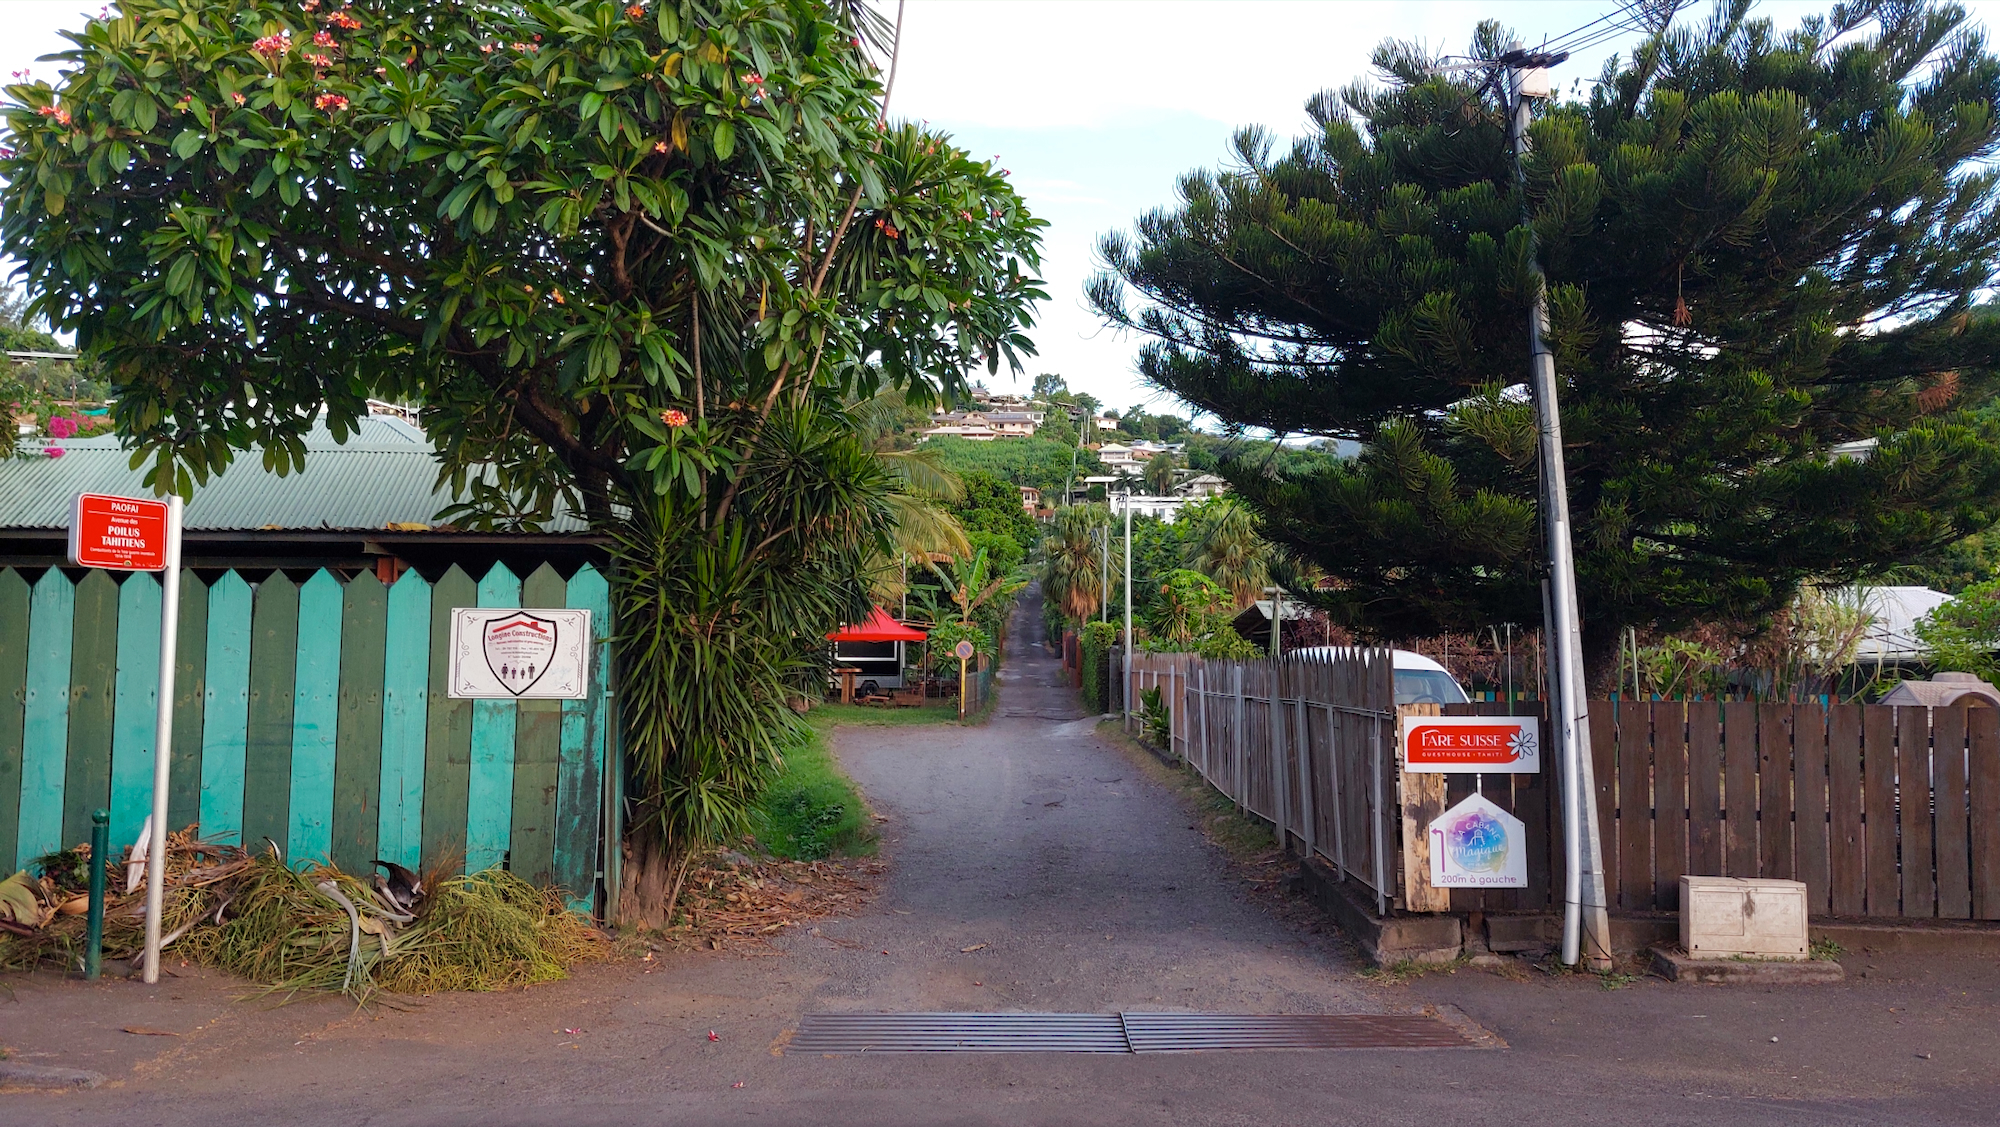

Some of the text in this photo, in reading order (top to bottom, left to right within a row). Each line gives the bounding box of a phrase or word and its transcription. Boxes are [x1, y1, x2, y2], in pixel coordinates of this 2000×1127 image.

[111, 502, 139, 513] PAOFAI
[111, 516, 129, 524] Avenue
[107, 525, 140, 537] POILUS
[101, 535, 146, 549] TAHITIENS
[487, 631, 511, 641] Longine
[511, 629, 553, 642] Constructions
[1421, 729, 1502, 746] FARE SUISSE
[1455, 821, 1501, 841] LA CABANE
[1455, 844, 1504, 860] Magique
[1441, 875, 1517, 885] 200m à gauche
